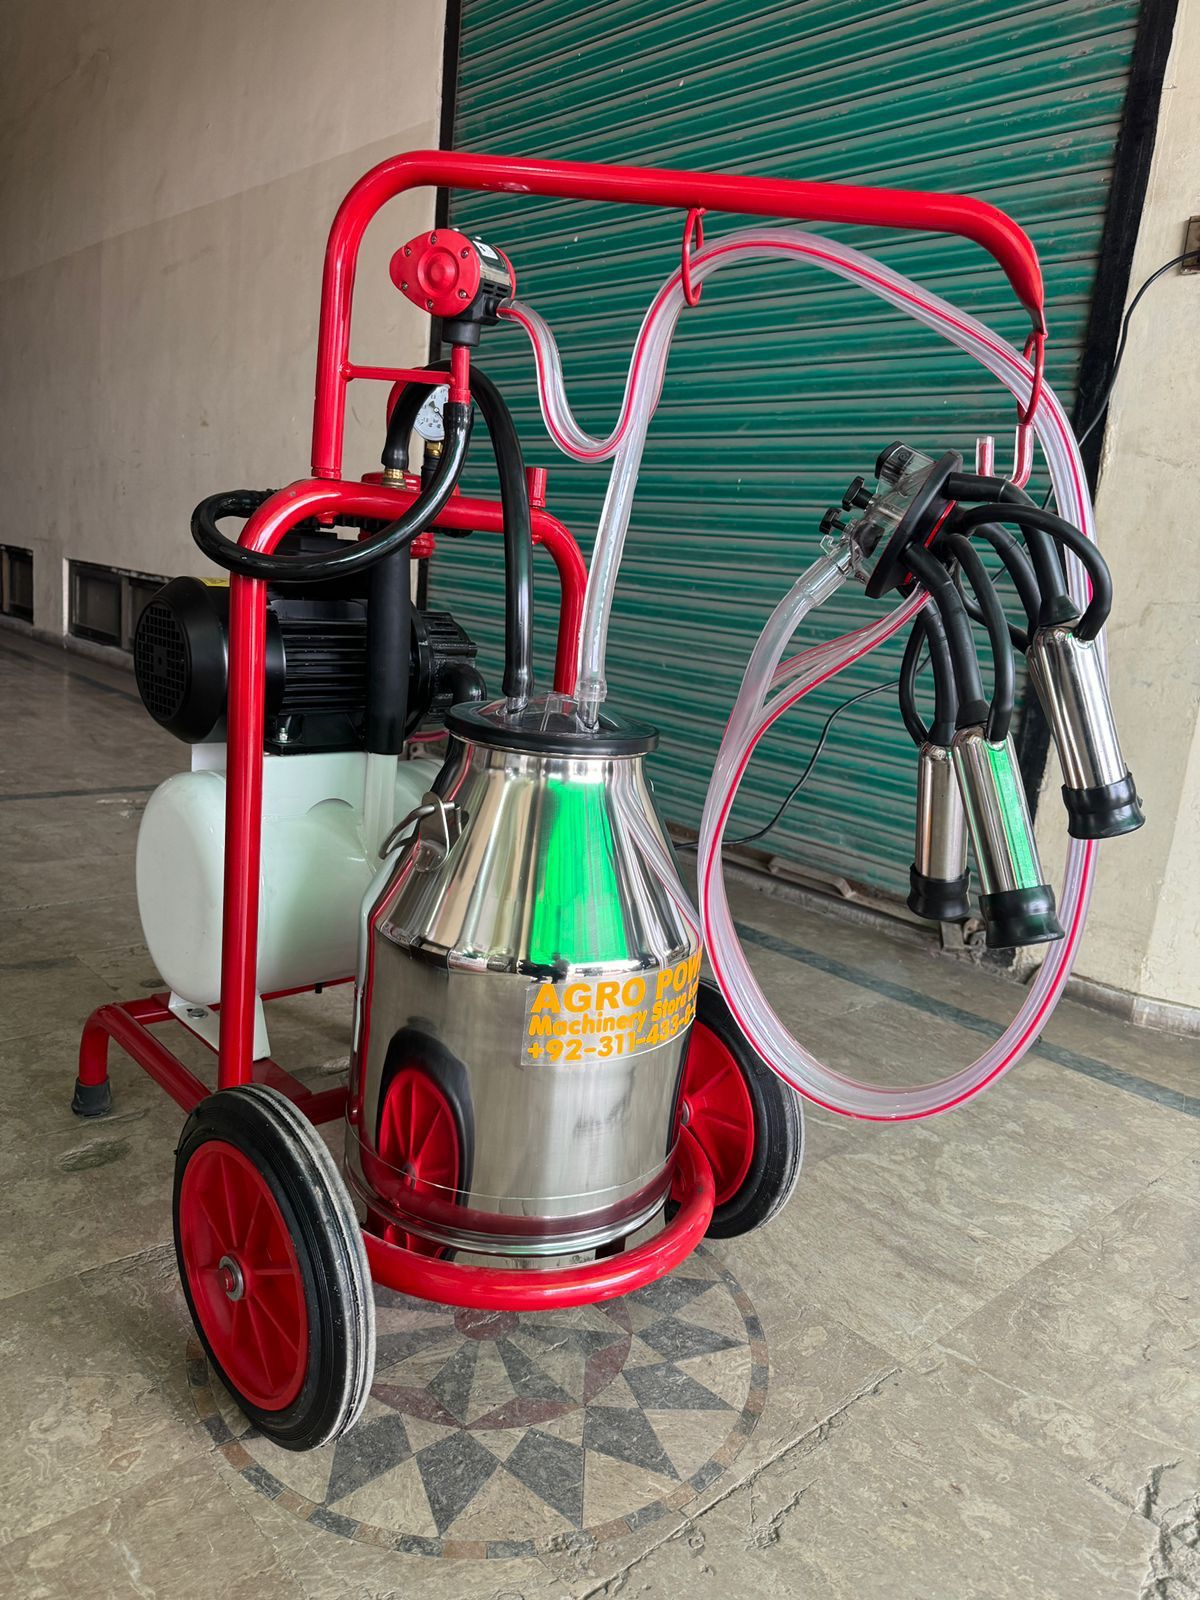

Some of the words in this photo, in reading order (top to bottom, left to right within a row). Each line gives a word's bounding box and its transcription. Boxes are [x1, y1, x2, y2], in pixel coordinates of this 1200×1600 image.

[528, 1010, 648, 1036] Machinery
[651, 991, 688, 1022] Store
[531, 976, 646, 1013] AGRO
